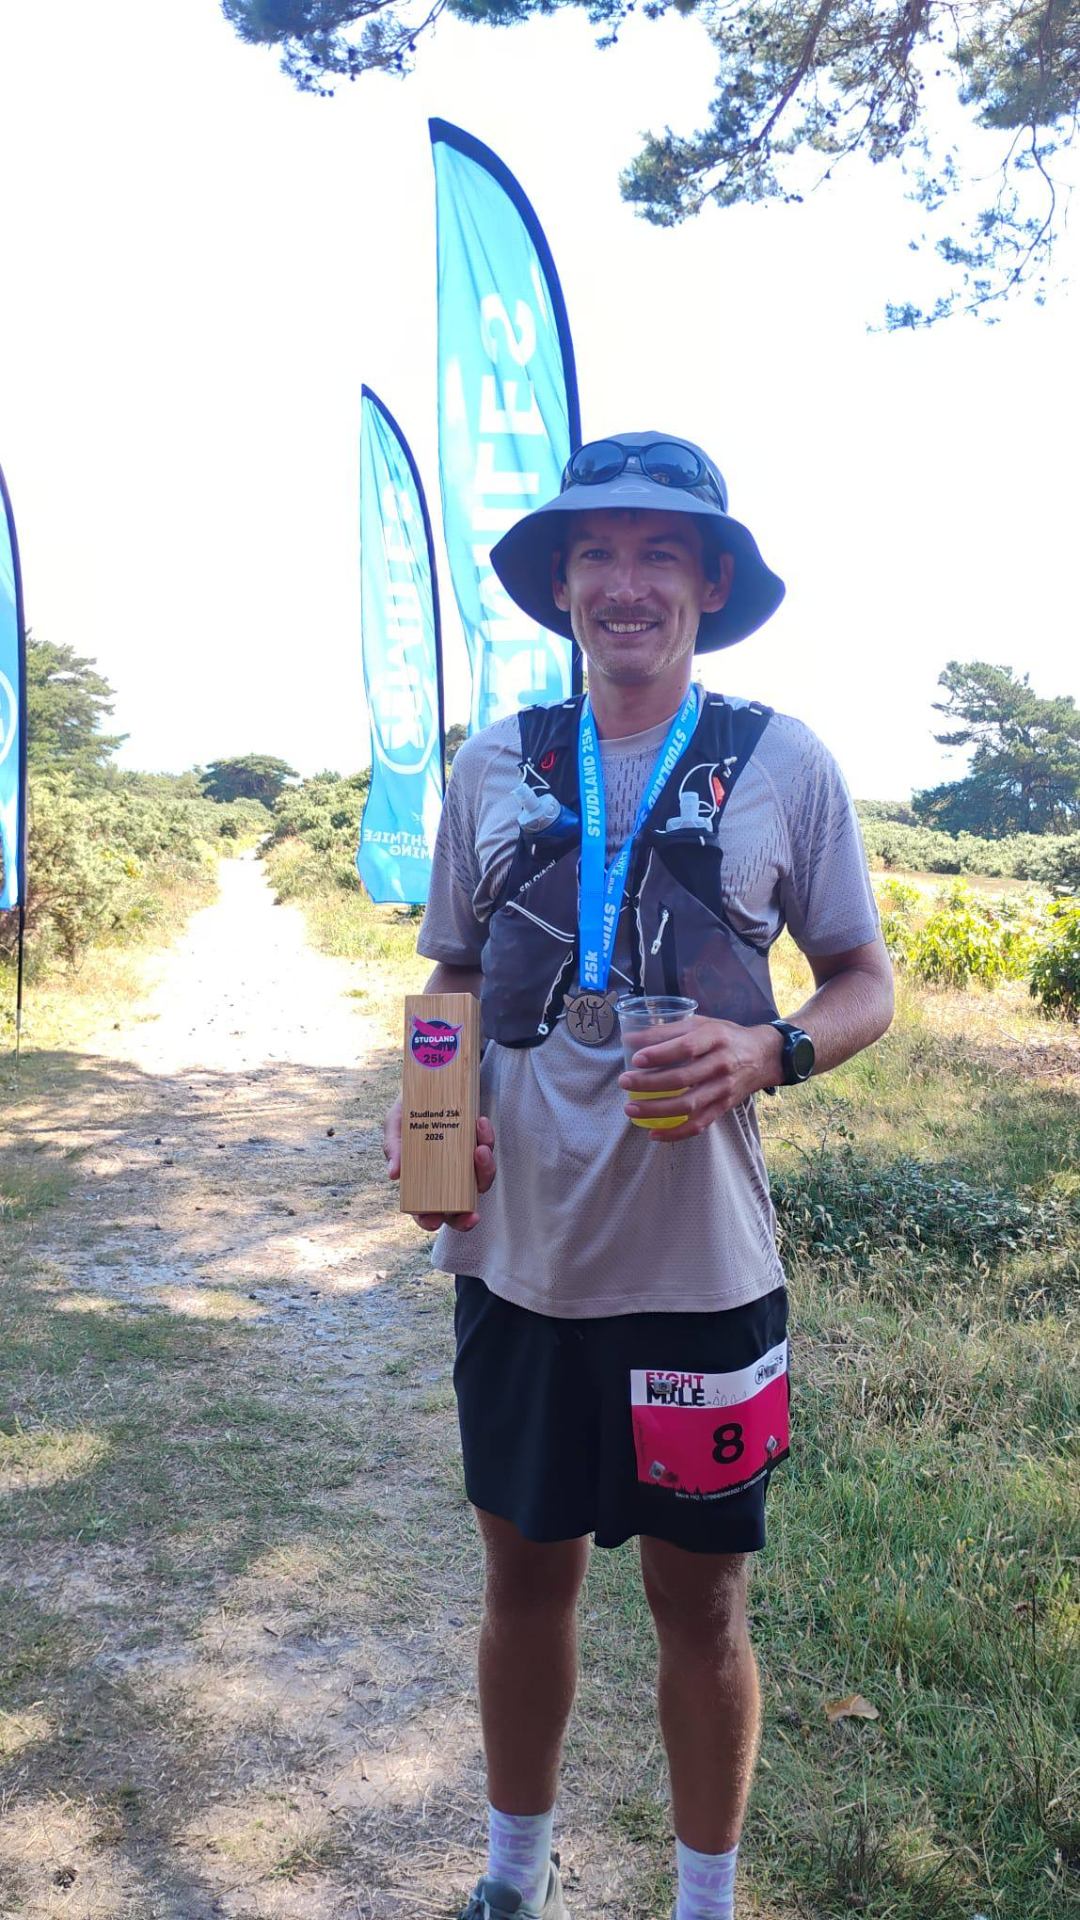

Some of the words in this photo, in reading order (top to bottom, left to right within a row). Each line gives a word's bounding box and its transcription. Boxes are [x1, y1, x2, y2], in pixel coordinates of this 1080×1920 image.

[582, 727, 594, 753] 25k
[583, 755, 600, 838] STUDLAND
[584, 950, 598, 984] 25k
[414, 1035, 455, 1044] STUDLAND
[423, 1053, 445, 1064] 25k
[409, 1110, 444, 1119] Studland
[446, 1109, 460, 1118] 25k
[409, 1122, 429, 1131] Male
[431, 1121, 460, 1131] Winner
[424, 1133, 444, 1142] 2026
[646, 1386, 706, 1407] MILE
[712, 1422, 745, 1465] 8
